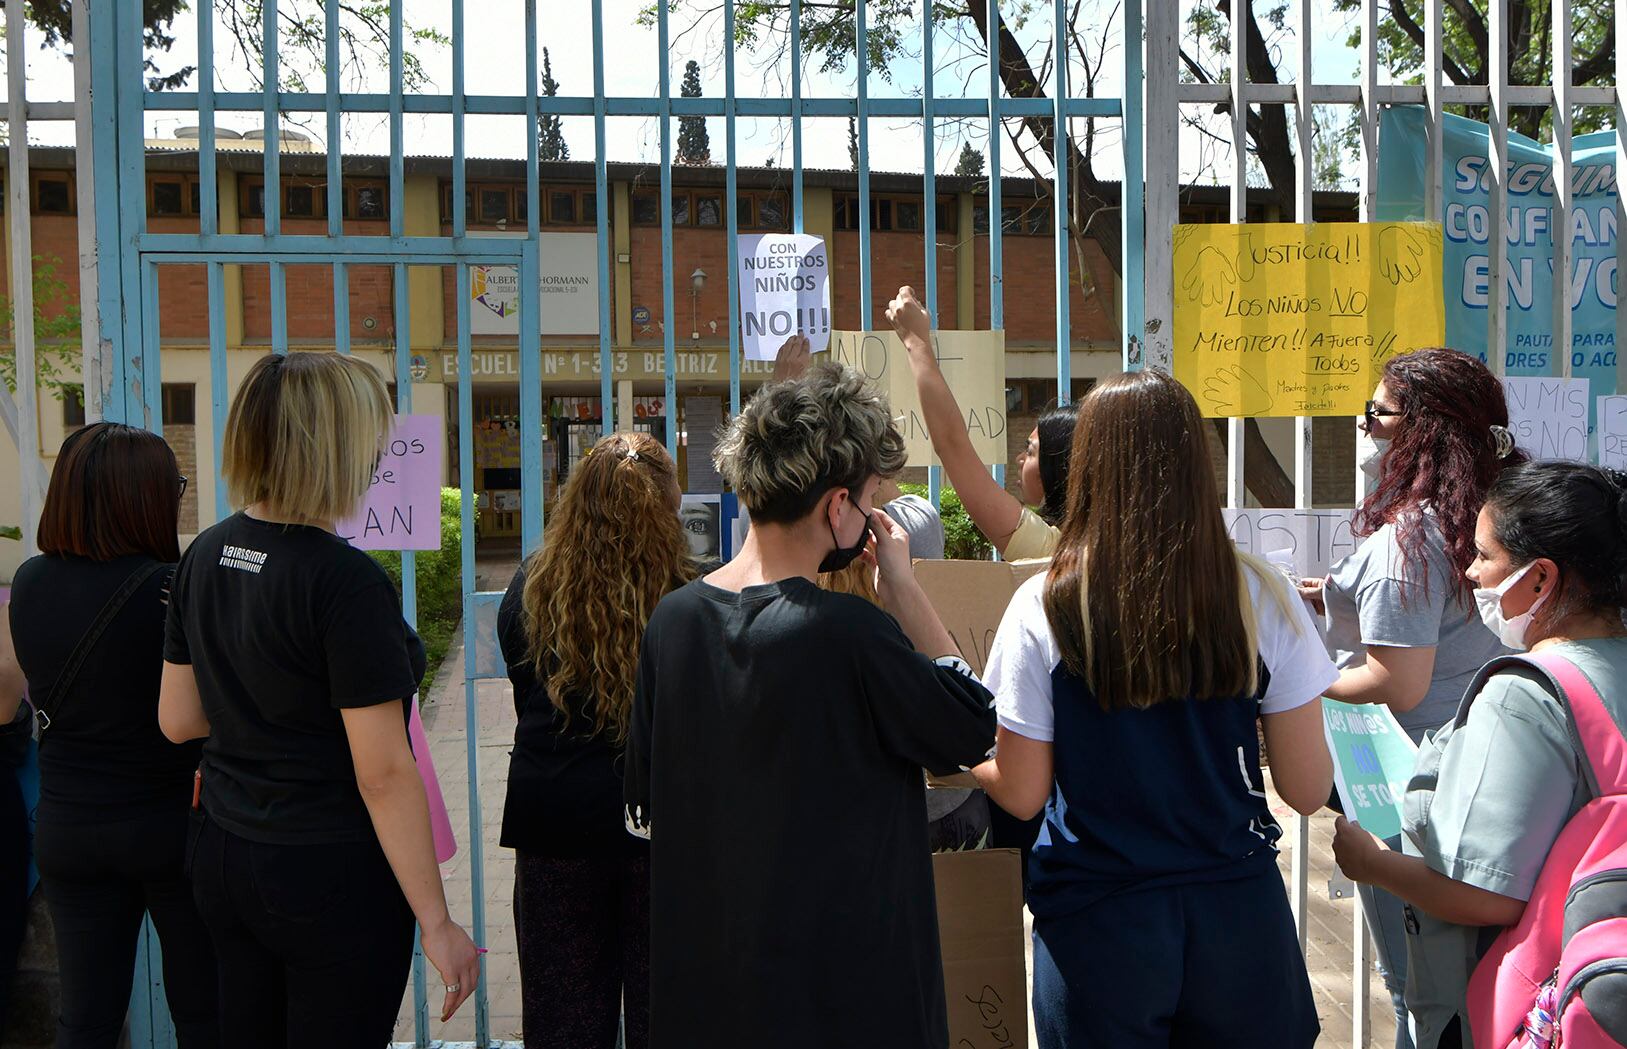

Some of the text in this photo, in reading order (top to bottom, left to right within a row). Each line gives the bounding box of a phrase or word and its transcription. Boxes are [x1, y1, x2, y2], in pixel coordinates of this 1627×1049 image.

[769, 243, 797, 254] CON
[744, 255, 825, 270] NUESTROS
[755, 272, 817, 293] NIÑOS
[1329, 286, 1369, 316] NO
[745, 307, 828, 337] NO!!!
[1573, 333, 1616, 347] PARA
[837, 334, 887, 381] NO
[1228, 513, 1357, 562] ASTA
[1351, 783, 1371, 808] SE
